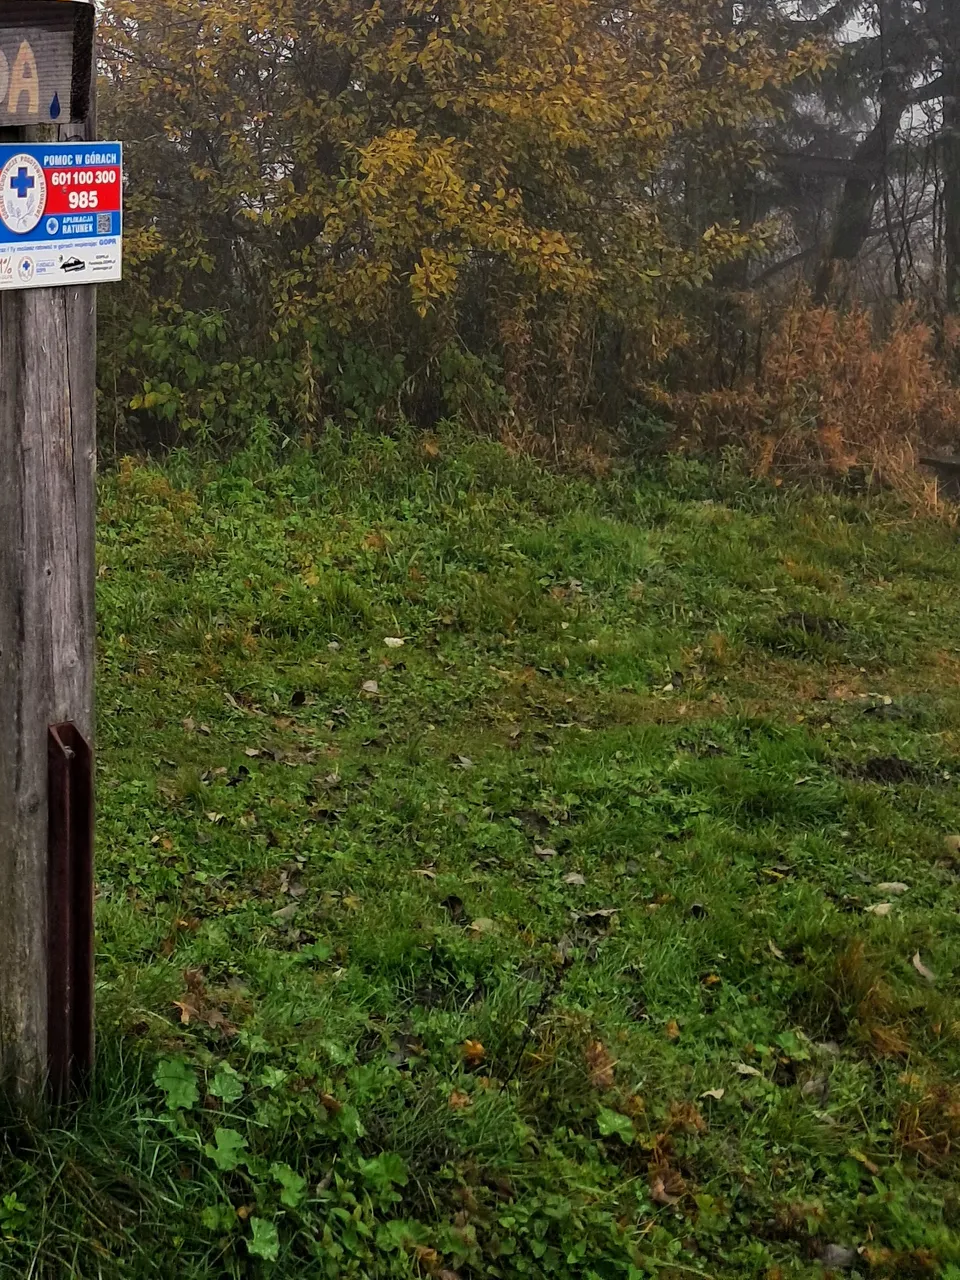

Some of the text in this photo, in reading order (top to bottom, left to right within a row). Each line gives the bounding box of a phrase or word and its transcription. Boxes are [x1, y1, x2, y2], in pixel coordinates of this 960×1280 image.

[43, 151, 117, 166] POMOC W GÓRACH
[95, 170, 116, 184] 300
[68, 190, 98, 209] 985
[62, 215, 94, 224] APLIKACJA
[62, 223, 94, 235] RATUNEK
[99, 238, 117, 246] GOPR
